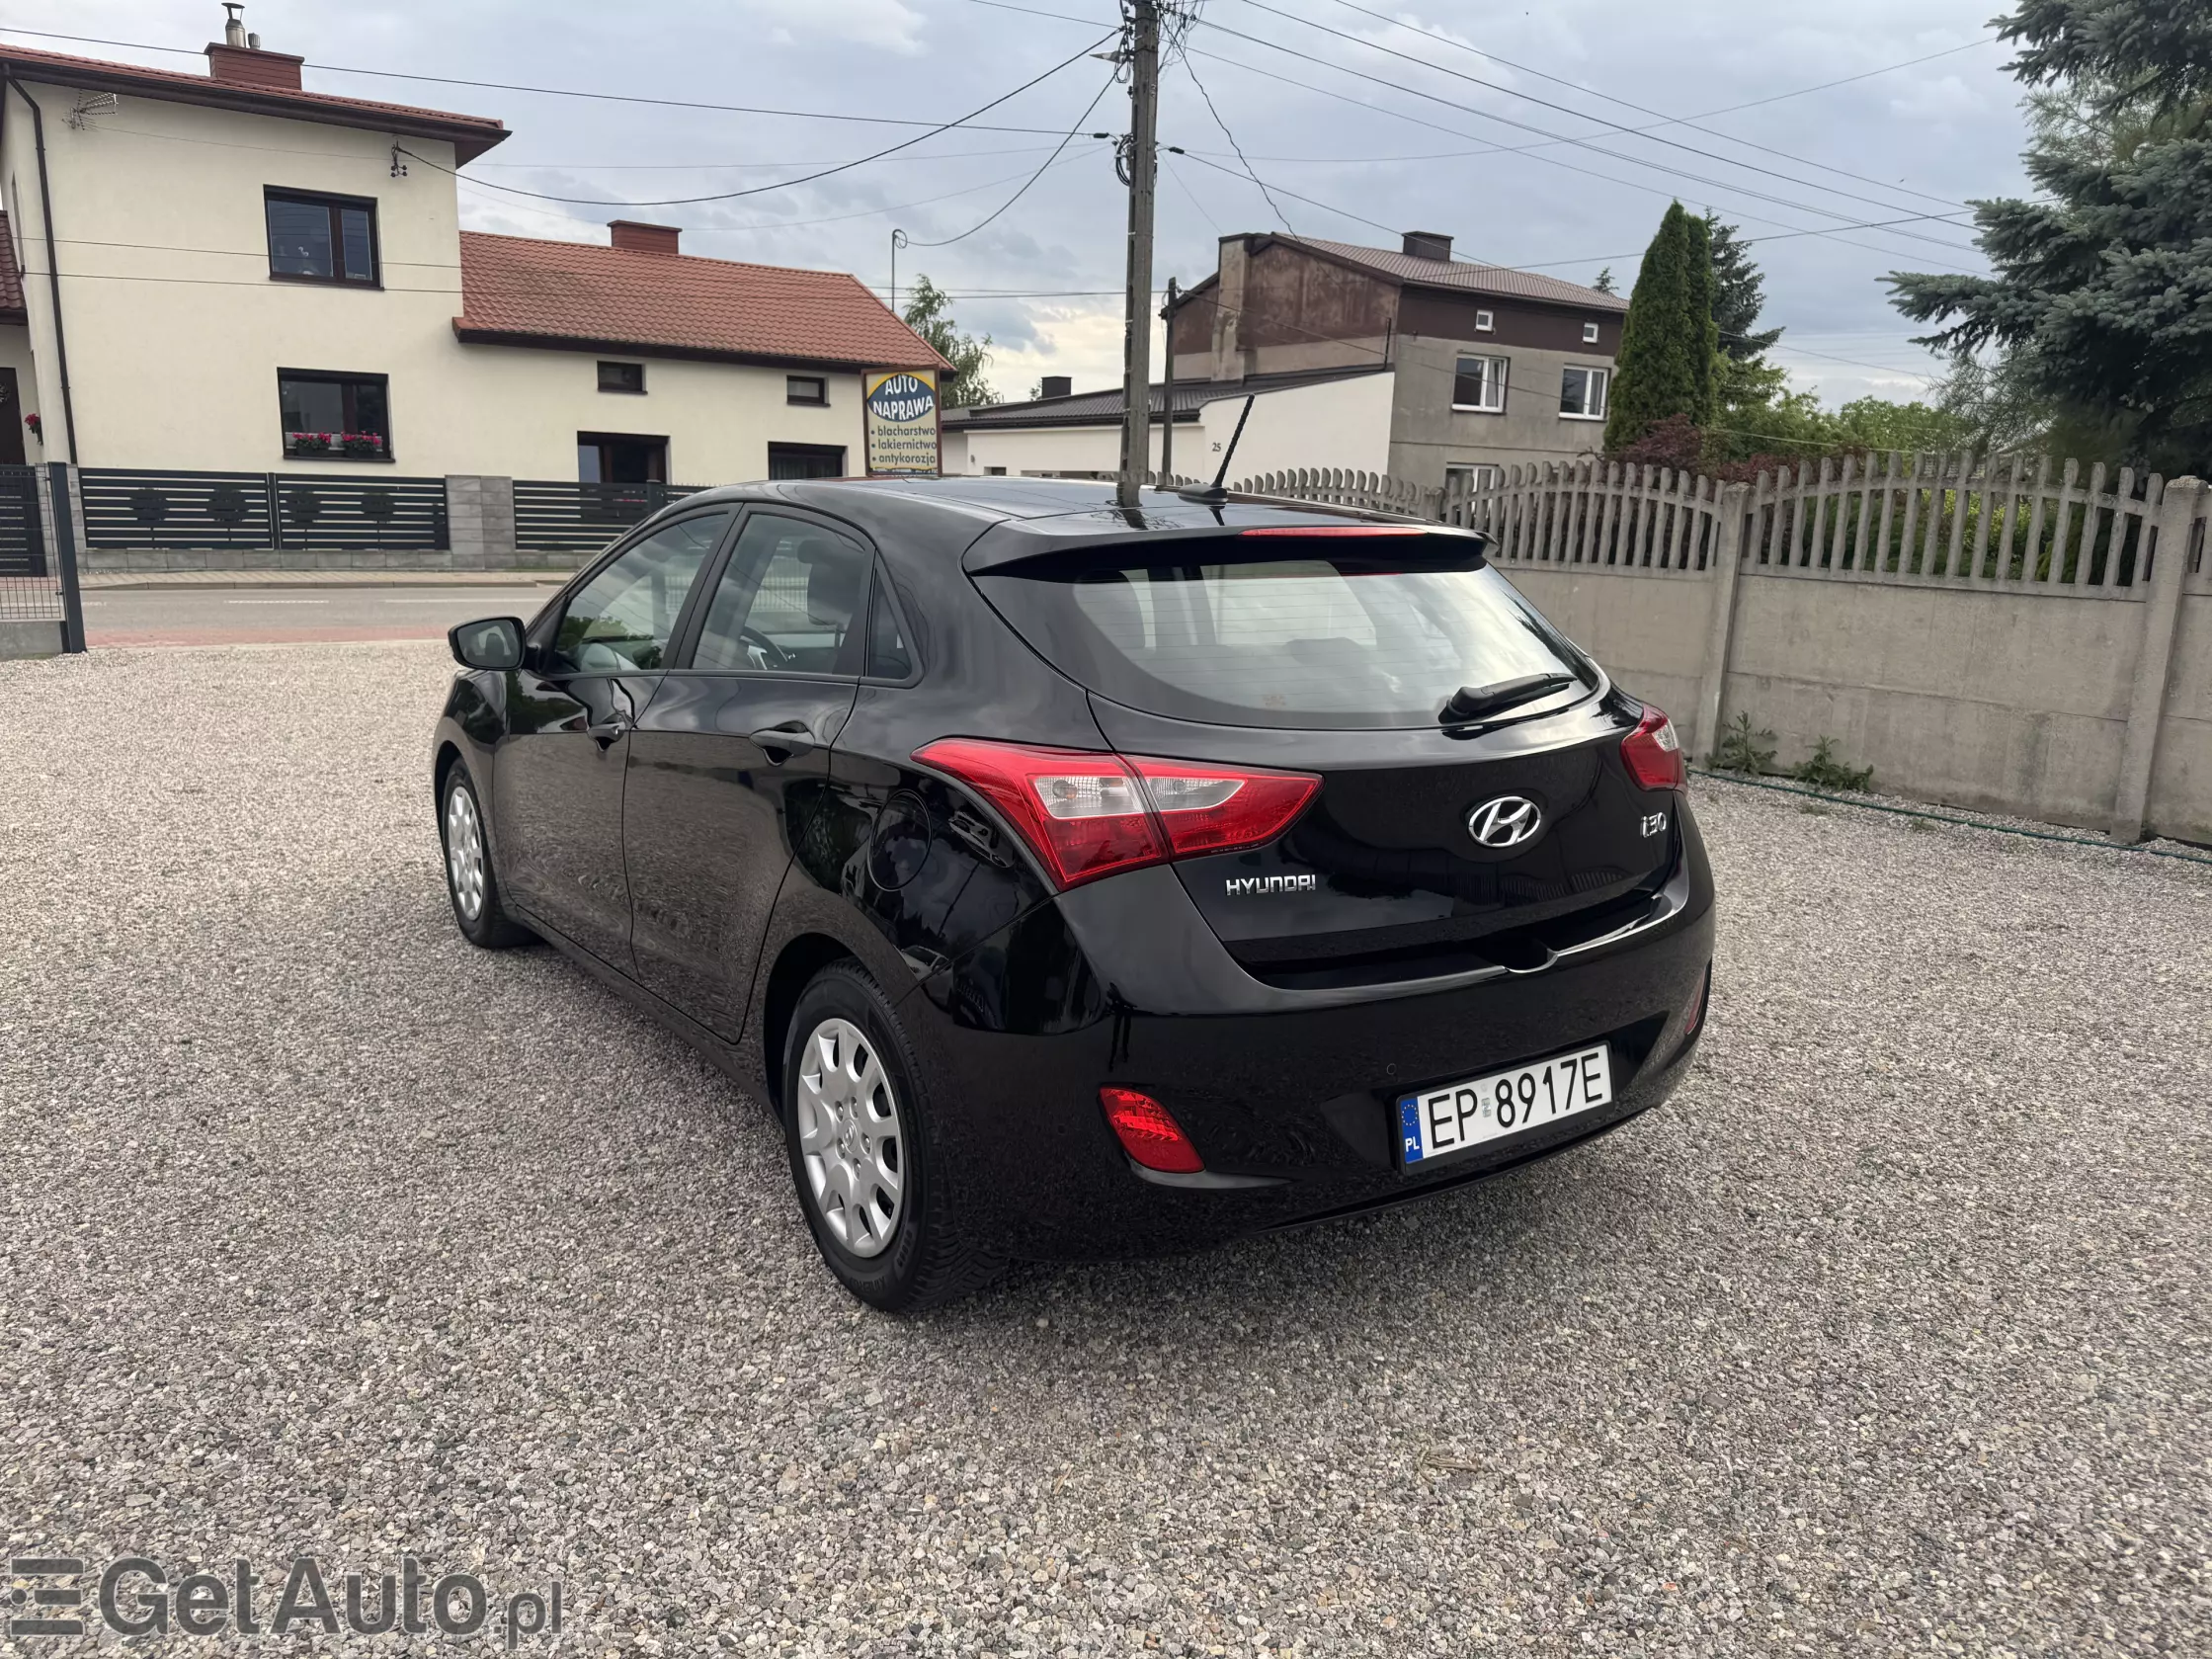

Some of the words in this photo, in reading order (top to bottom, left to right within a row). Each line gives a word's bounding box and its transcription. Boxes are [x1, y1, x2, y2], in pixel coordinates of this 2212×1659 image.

[885, 374, 918, 395] AUTO
[872, 395, 934, 420] NAPRAWA
[877, 425, 936, 437] blacharstwo
[877, 438, 937, 450] lakiernictwo
[1212, 442, 1221, 453] 25
[878, 453, 936, 466] antykorozja
[1226, 873, 1316, 896] HYUNDAI
[1428, 1088, 1478, 1149] EP
[1495, 1052, 1603, 1128] 8917E
[1405, 1137, 1420, 1152] PL
